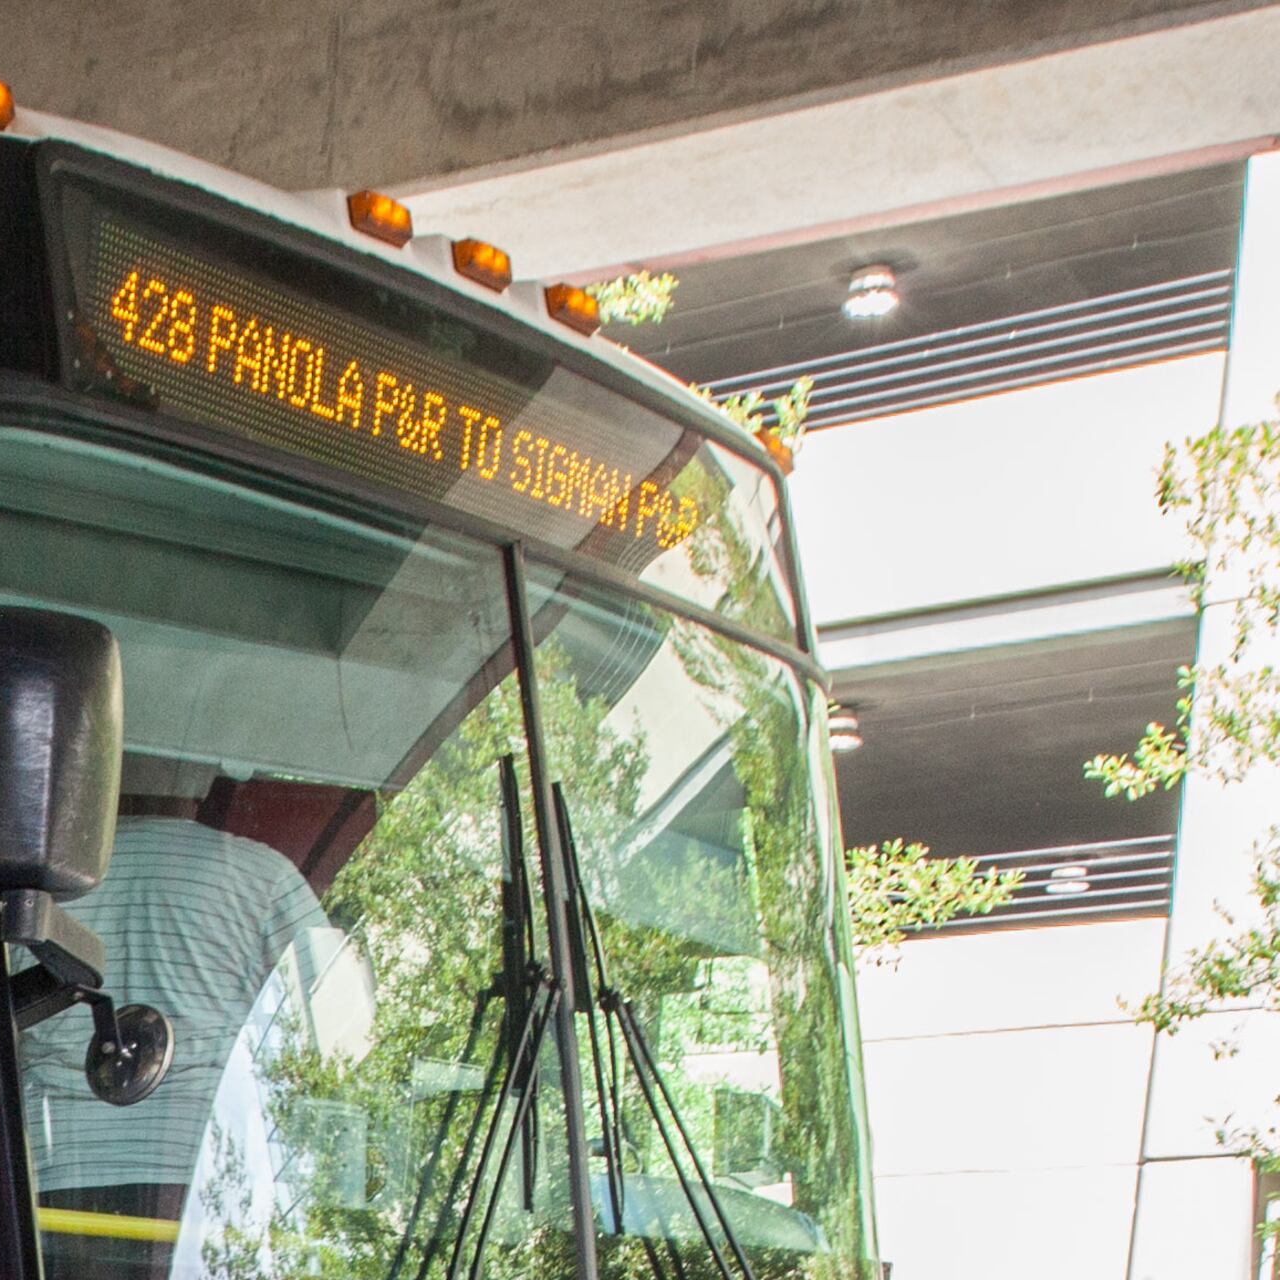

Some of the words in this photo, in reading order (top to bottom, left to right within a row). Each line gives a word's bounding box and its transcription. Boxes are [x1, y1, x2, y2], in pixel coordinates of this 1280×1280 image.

[111, 270, 197, 365] 428
[207, 303, 365, 429] PANOLA
[372, 371, 447, 462] P&R
[459, 404, 503, 480] TO
[510, 429, 632, 532] SIGMAN
